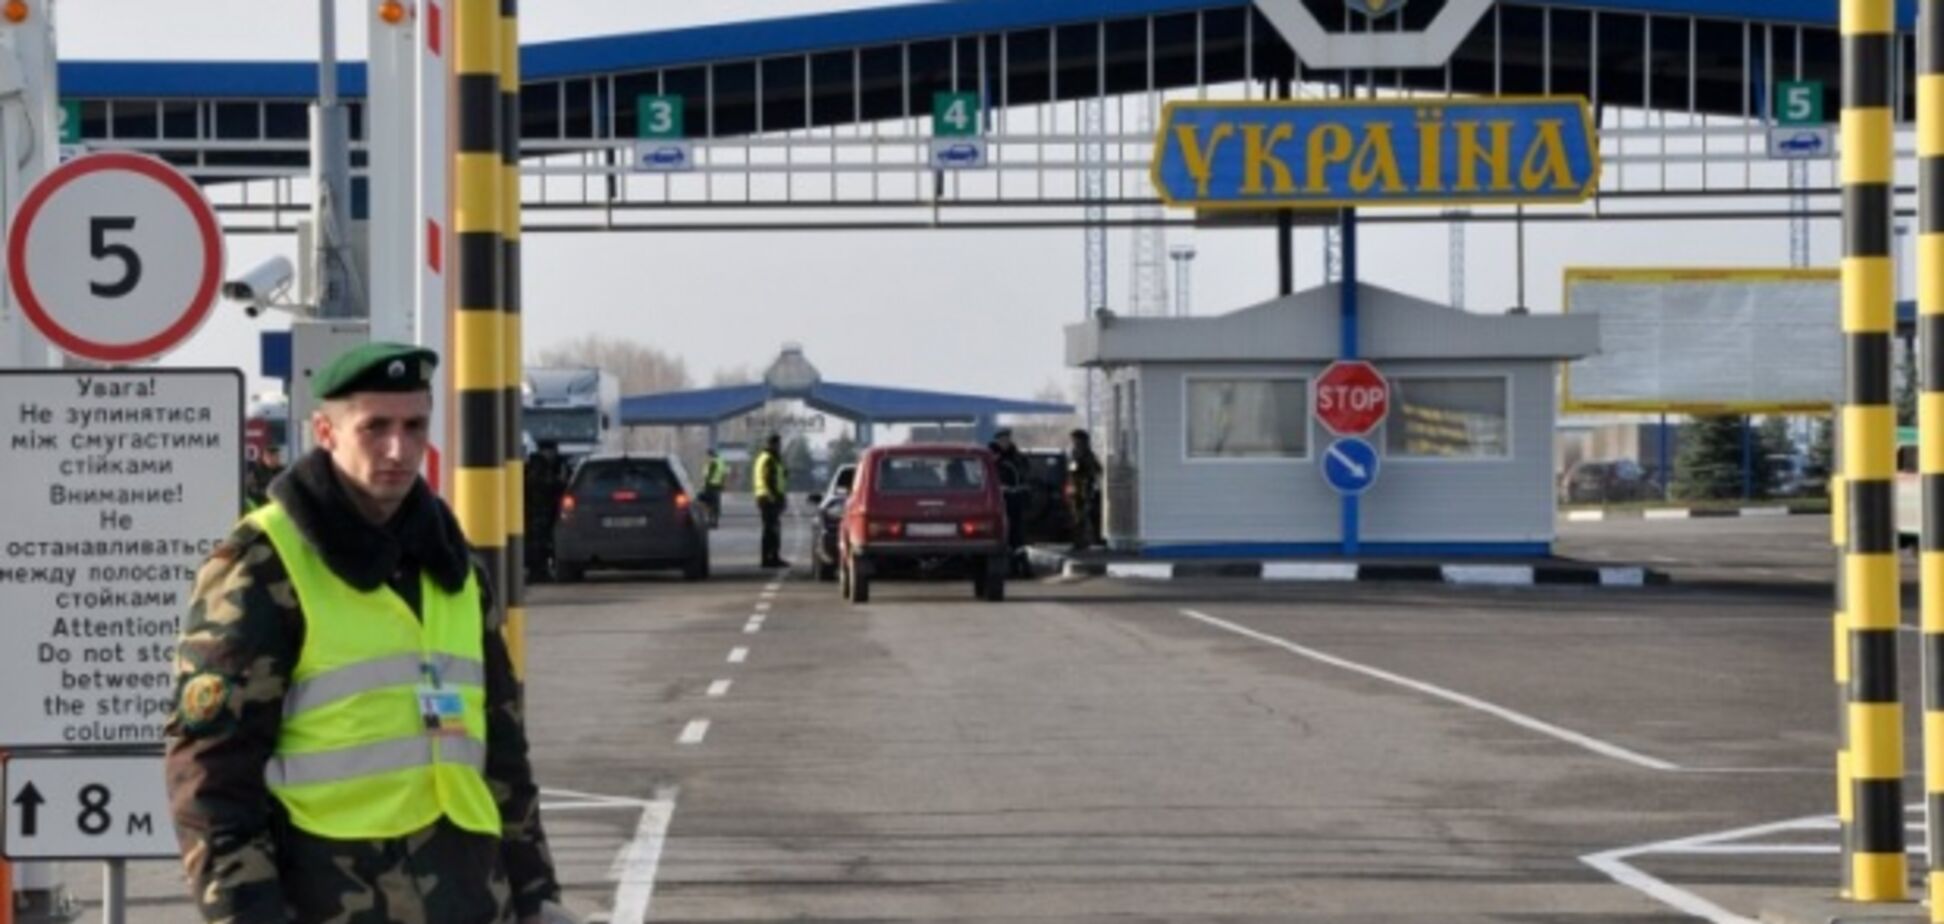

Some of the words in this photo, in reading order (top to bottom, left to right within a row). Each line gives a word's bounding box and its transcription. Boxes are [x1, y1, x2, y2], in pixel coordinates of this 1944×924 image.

[943, 99, 969, 130] 4
[1788, 87, 1811, 119] 5
[648, 101, 673, 133] 3
[1174, 108, 1579, 195] УКРАЇНА
[90, 215, 142, 298] 5
[77, 378, 156, 397] Увага!
[1319, 385, 1384, 411] STOP
[19, 404, 53, 424] Не
[66, 406, 211, 428] зупинятися
[11, 430, 58, 449] між
[71, 432, 220, 454] смугастими
[58, 454, 173, 475] стійками
[49, 484, 184, 505] Внимание!
[100, 510, 133, 531] Не
[55, 588, 177, 609] стойками
[52, 616, 180, 637] Attention!
[37, 643, 71, 663] Do
[84, 643, 124, 663] not
[137, 643, 175, 663] sto
[61, 669, 170, 690] between
[44, 696, 85, 716] the
[97, 696, 175, 718] stripe
[77, 783, 111, 835] 8
